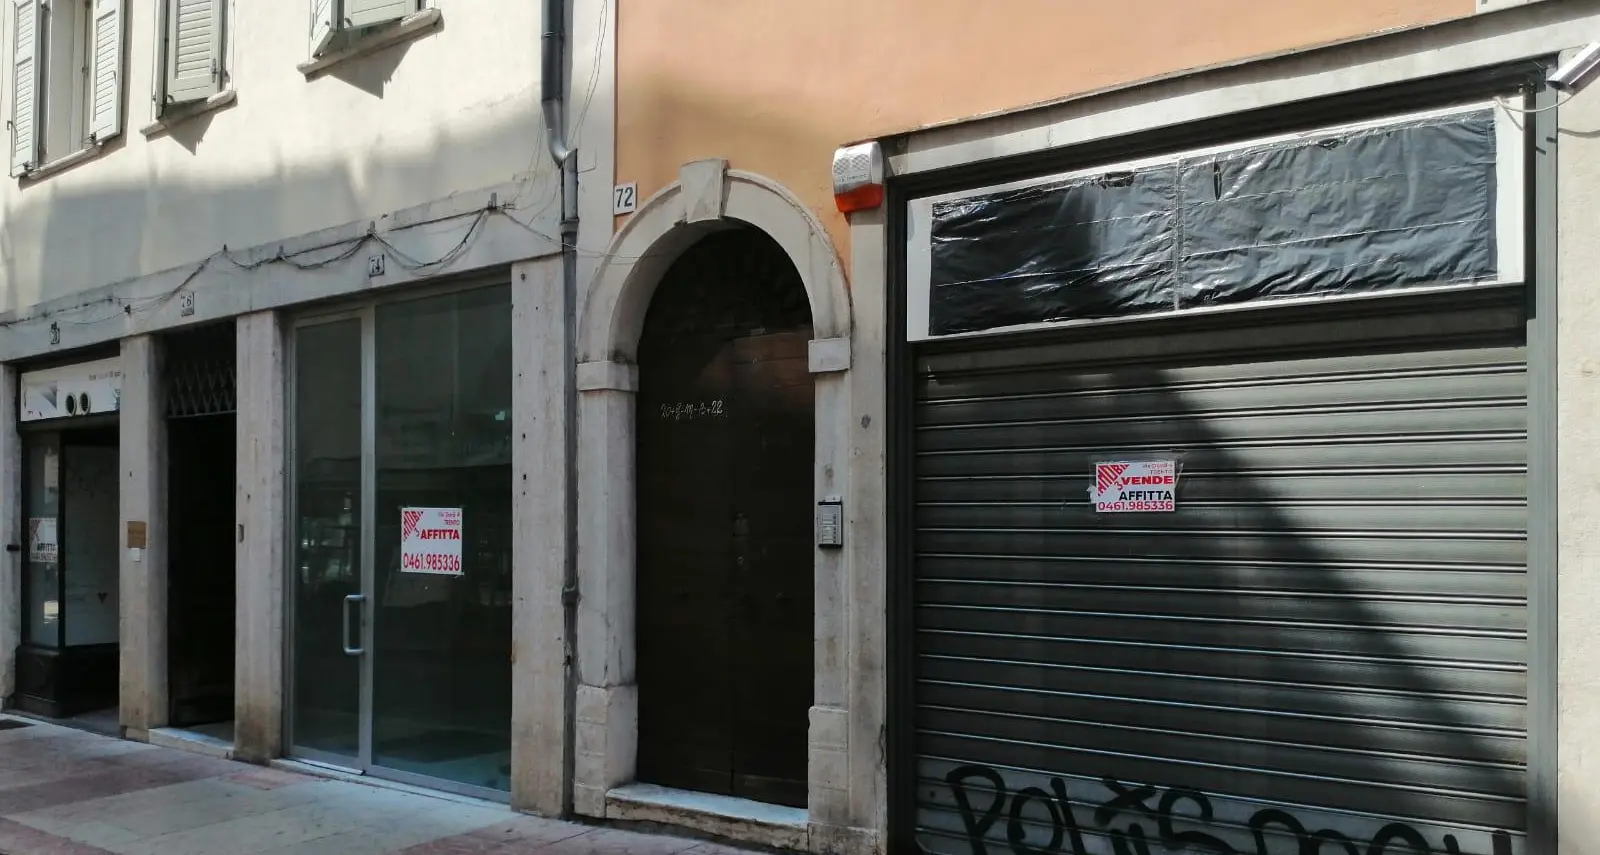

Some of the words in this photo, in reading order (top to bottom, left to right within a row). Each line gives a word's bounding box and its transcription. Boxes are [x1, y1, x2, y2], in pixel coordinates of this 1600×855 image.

[616, 186, 634, 208] 72
[371, 258, 381, 273] 74
[1121, 475, 1174, 485] VENDE
[1119, 490, 1173, 501] AFFITTA
[1097, 500, 1174, 511] 0461.985336
[420, 529, 460, 540] AFFITTA
[403, 552, 460, 572] 0461.985336
